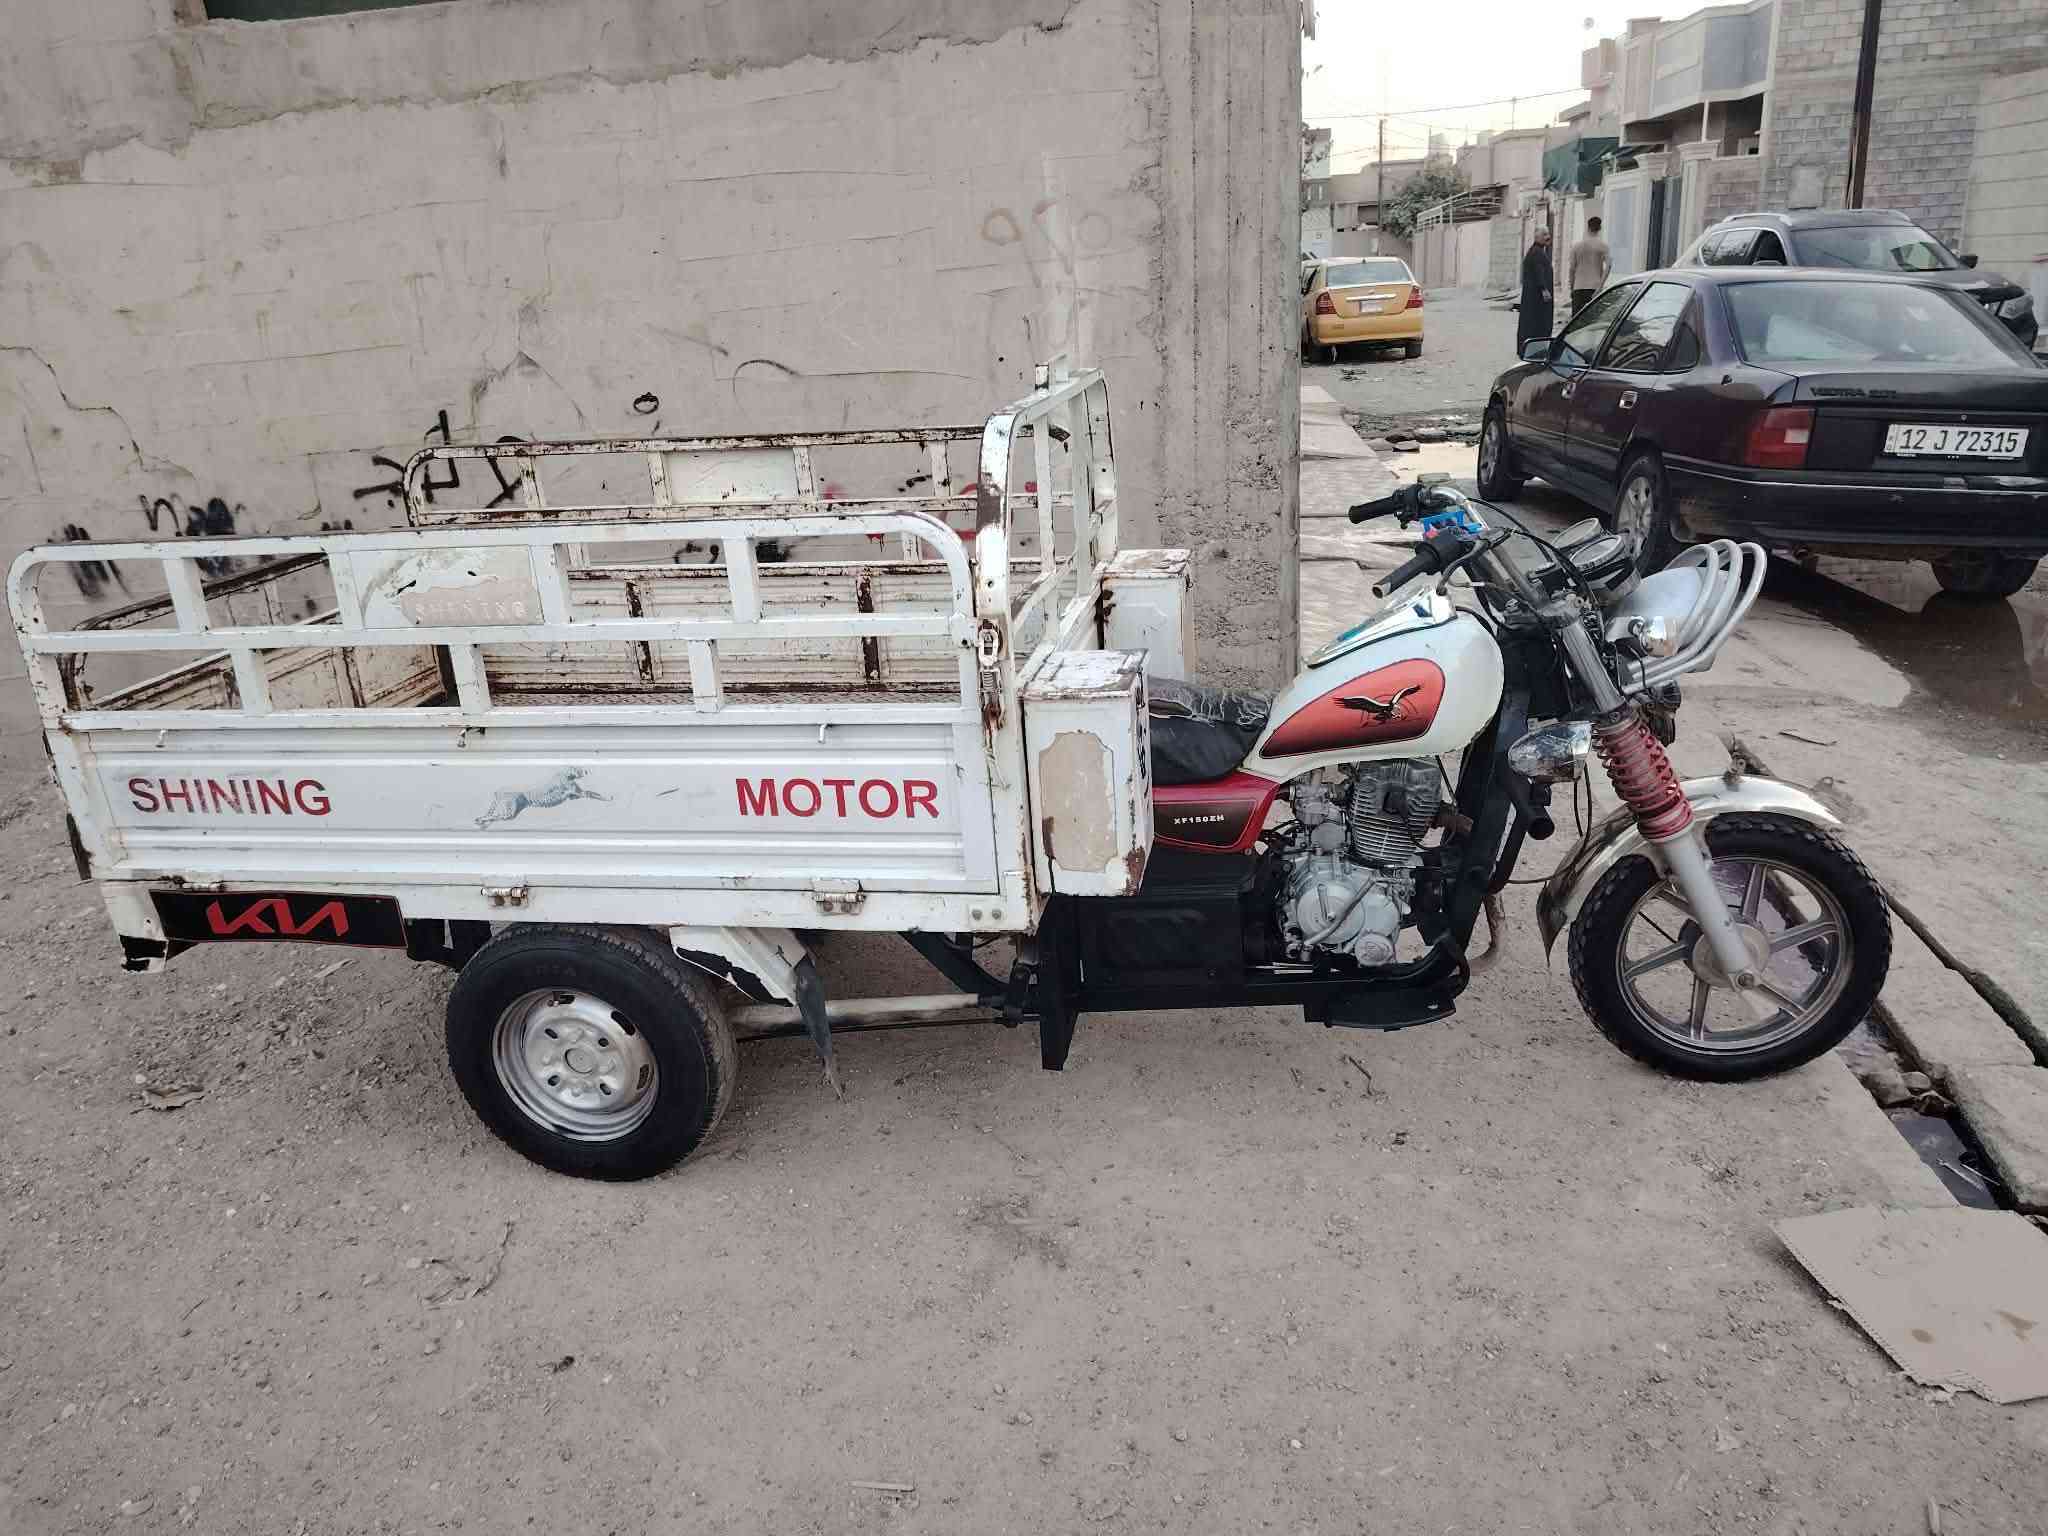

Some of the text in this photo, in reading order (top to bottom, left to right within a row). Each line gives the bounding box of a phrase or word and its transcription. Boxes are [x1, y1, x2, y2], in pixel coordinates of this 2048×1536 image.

[1899, 428, 1928, 450] 12
[1933, 429, 1949, 451] J
[1954, 430, 2020, 453] 72315
[128, 778, 332, 816] SHINING
[735, 778, 940, 819] MOTOR
[206, 899, 349, 937] KIA
